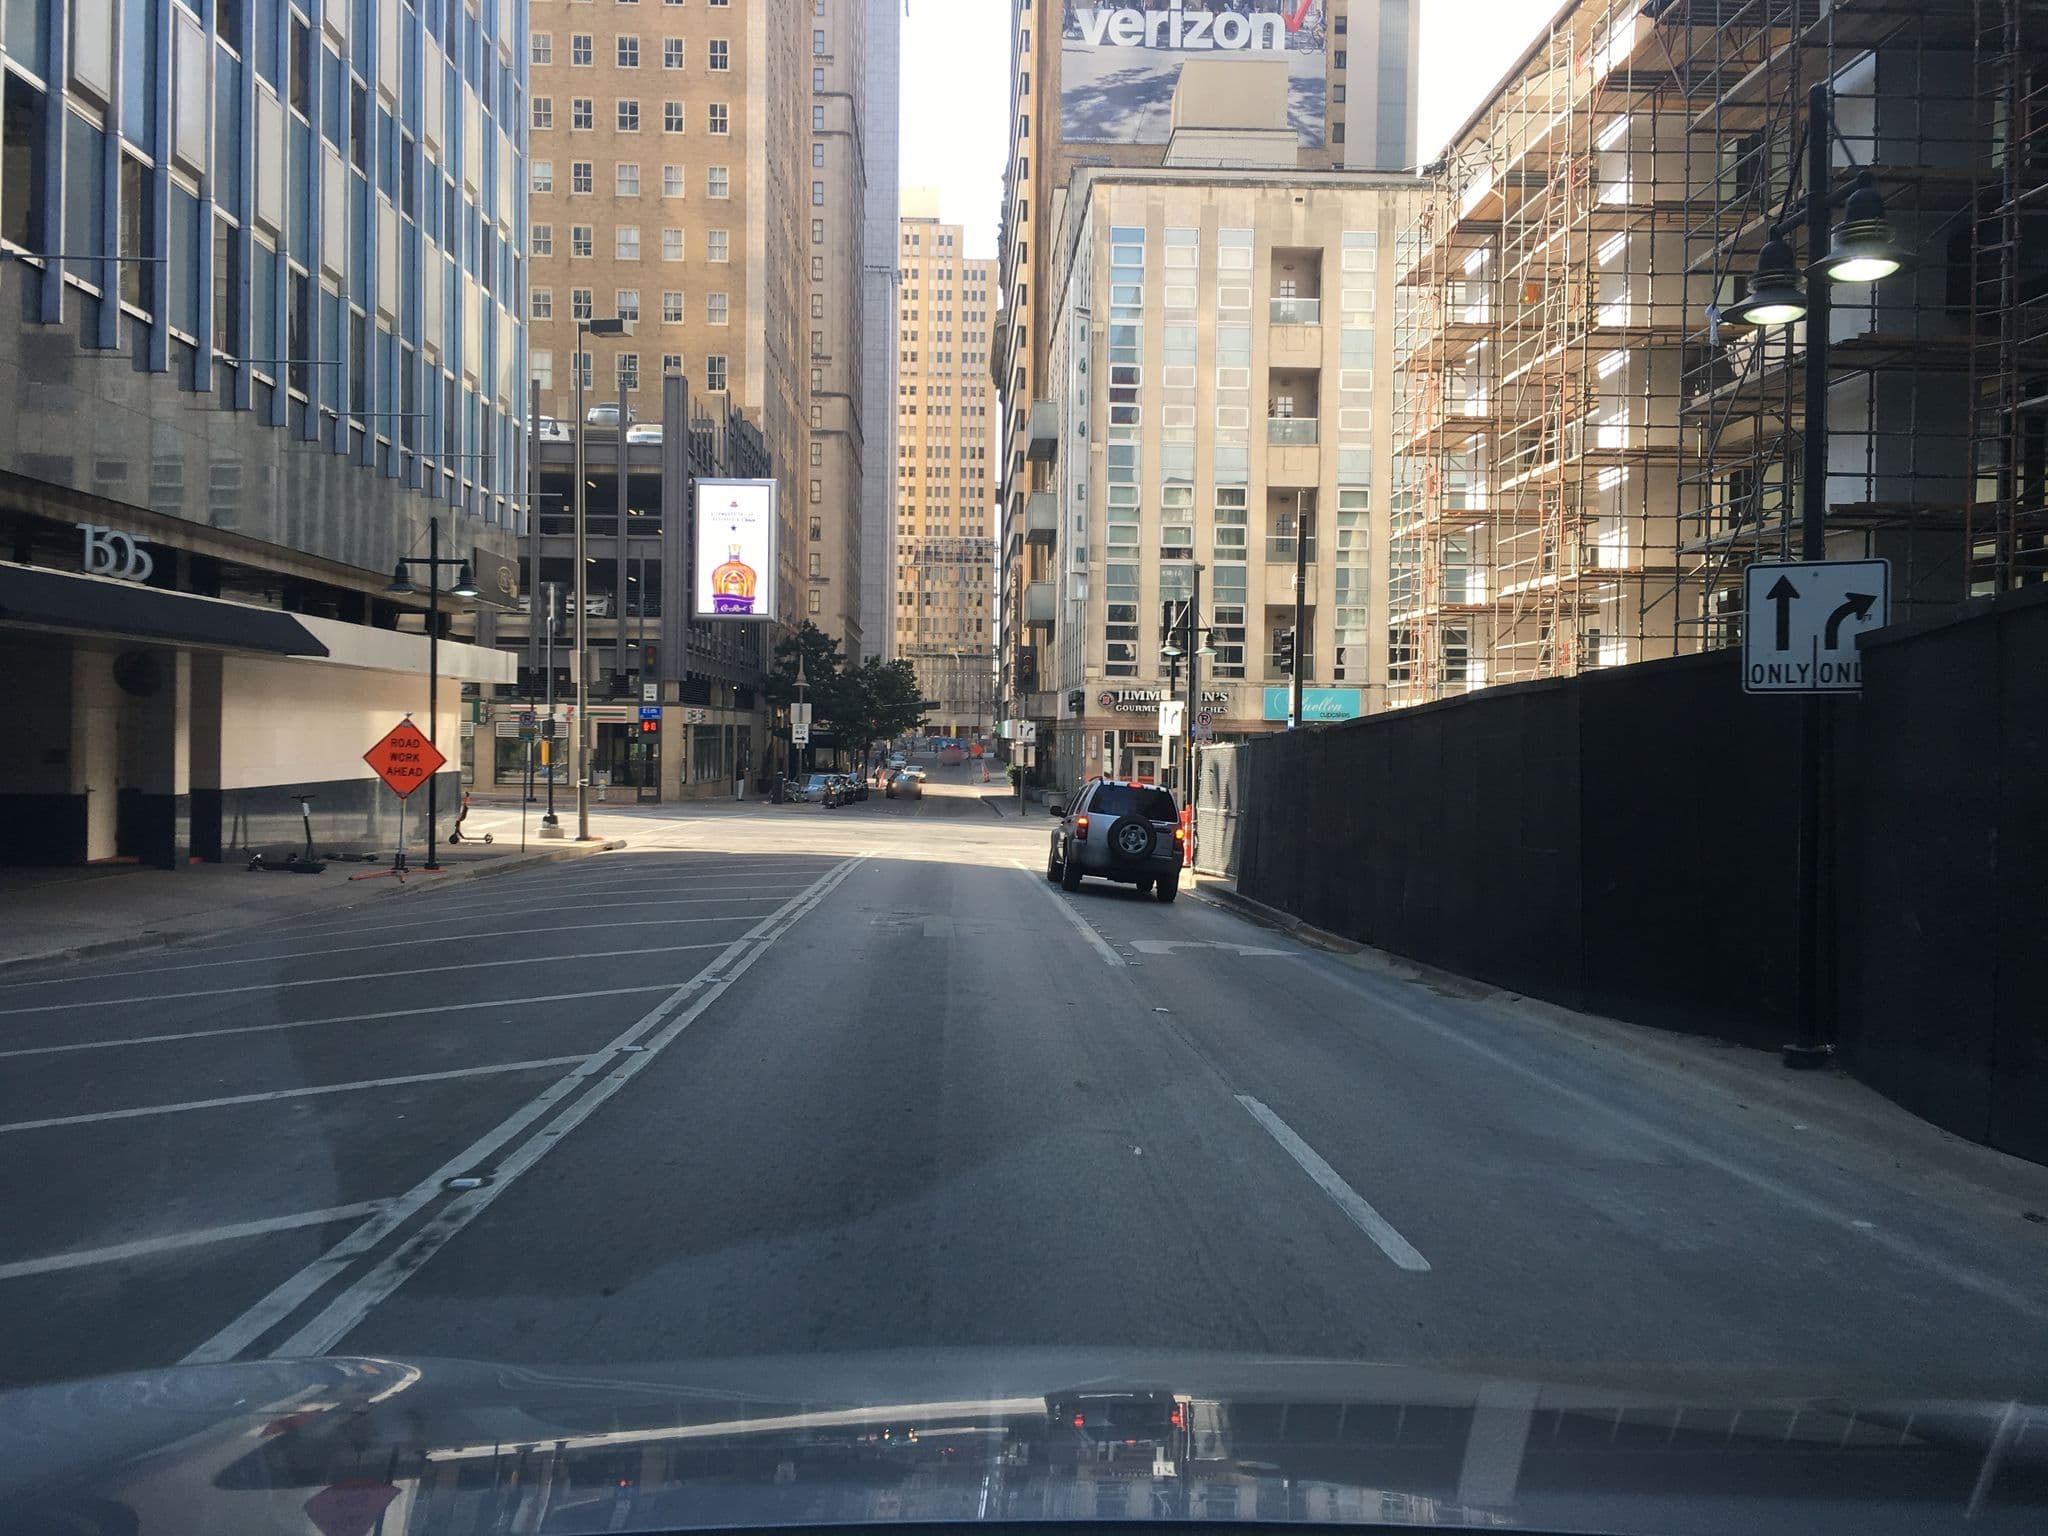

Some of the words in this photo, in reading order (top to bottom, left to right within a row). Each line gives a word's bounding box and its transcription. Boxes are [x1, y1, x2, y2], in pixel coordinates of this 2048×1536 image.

[1076, 0, 1286, 50] verizon
[1752, 663, 1810, 684] ONLY
[1820, 662, 1863, 683] ONL
[1118, 690, 1160, 702] JIMM
[390, 738, 420, 748] ROAD
[390, 752, 420, 762] WORK
[385, 767, 423, 777] AHEAD
